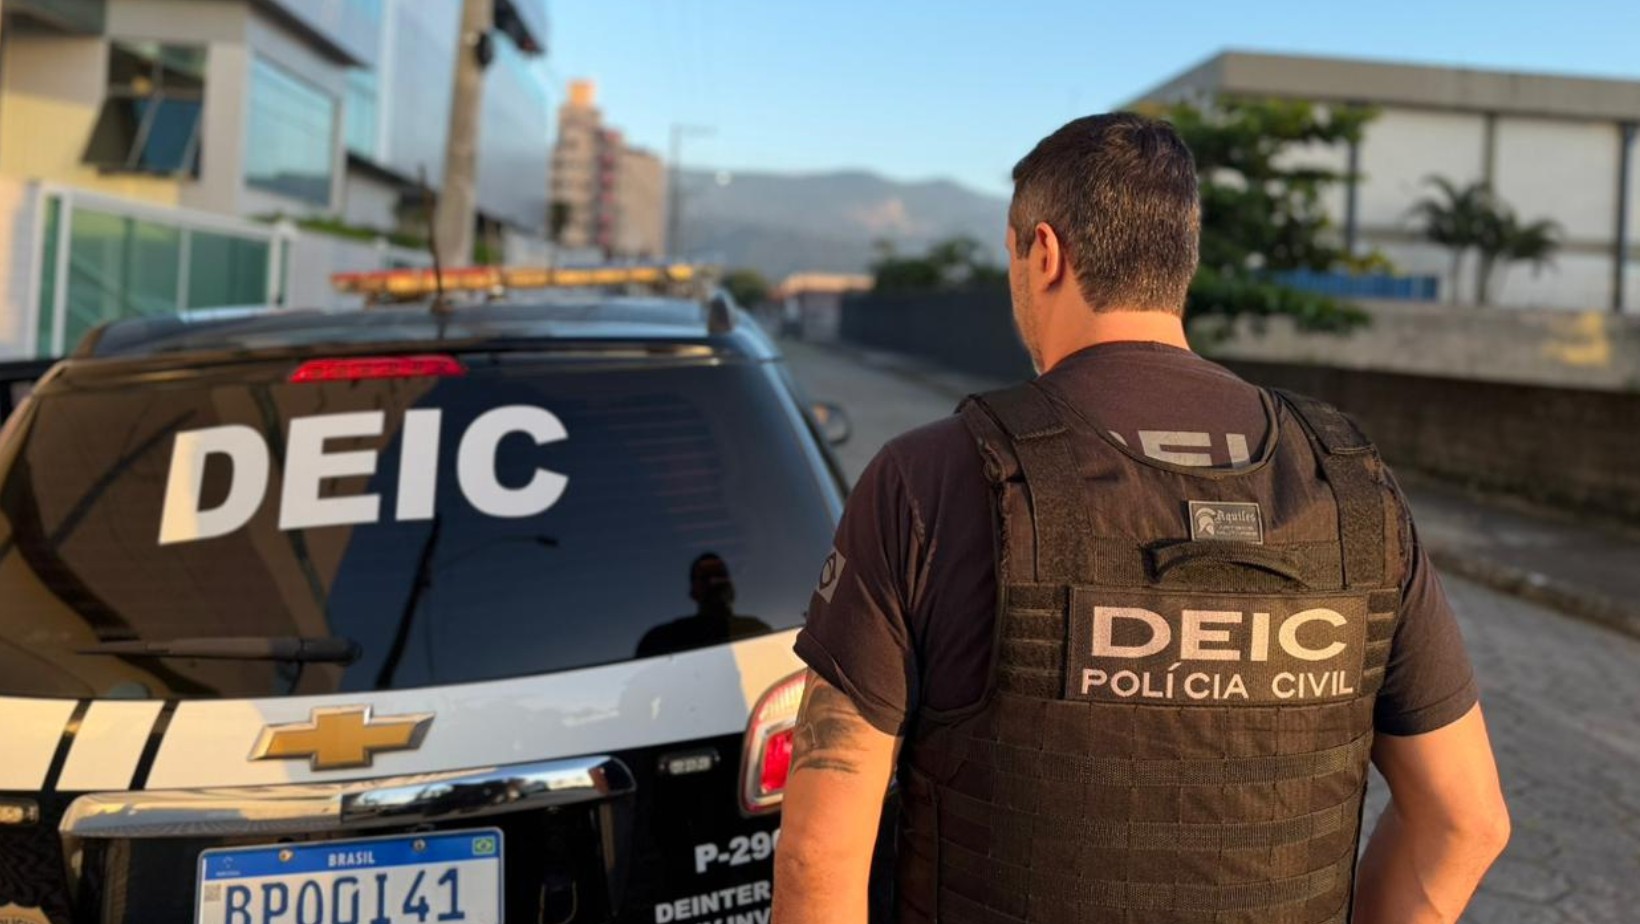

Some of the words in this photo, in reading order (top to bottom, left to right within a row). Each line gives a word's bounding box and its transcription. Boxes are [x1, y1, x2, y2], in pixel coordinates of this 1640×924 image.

[1108, 430, 1250, 468] EI
[158, 404, 569, 545] DEIC
[1091, 606, 1348, 661] DEIC
[1081, 662, 1249, 699] POLÍCIA
[1272, 670, 1354, 698] CIVIL
[328, 852, 375, 867] BRASIL
[655, 880, 771, 924] DEINTER
